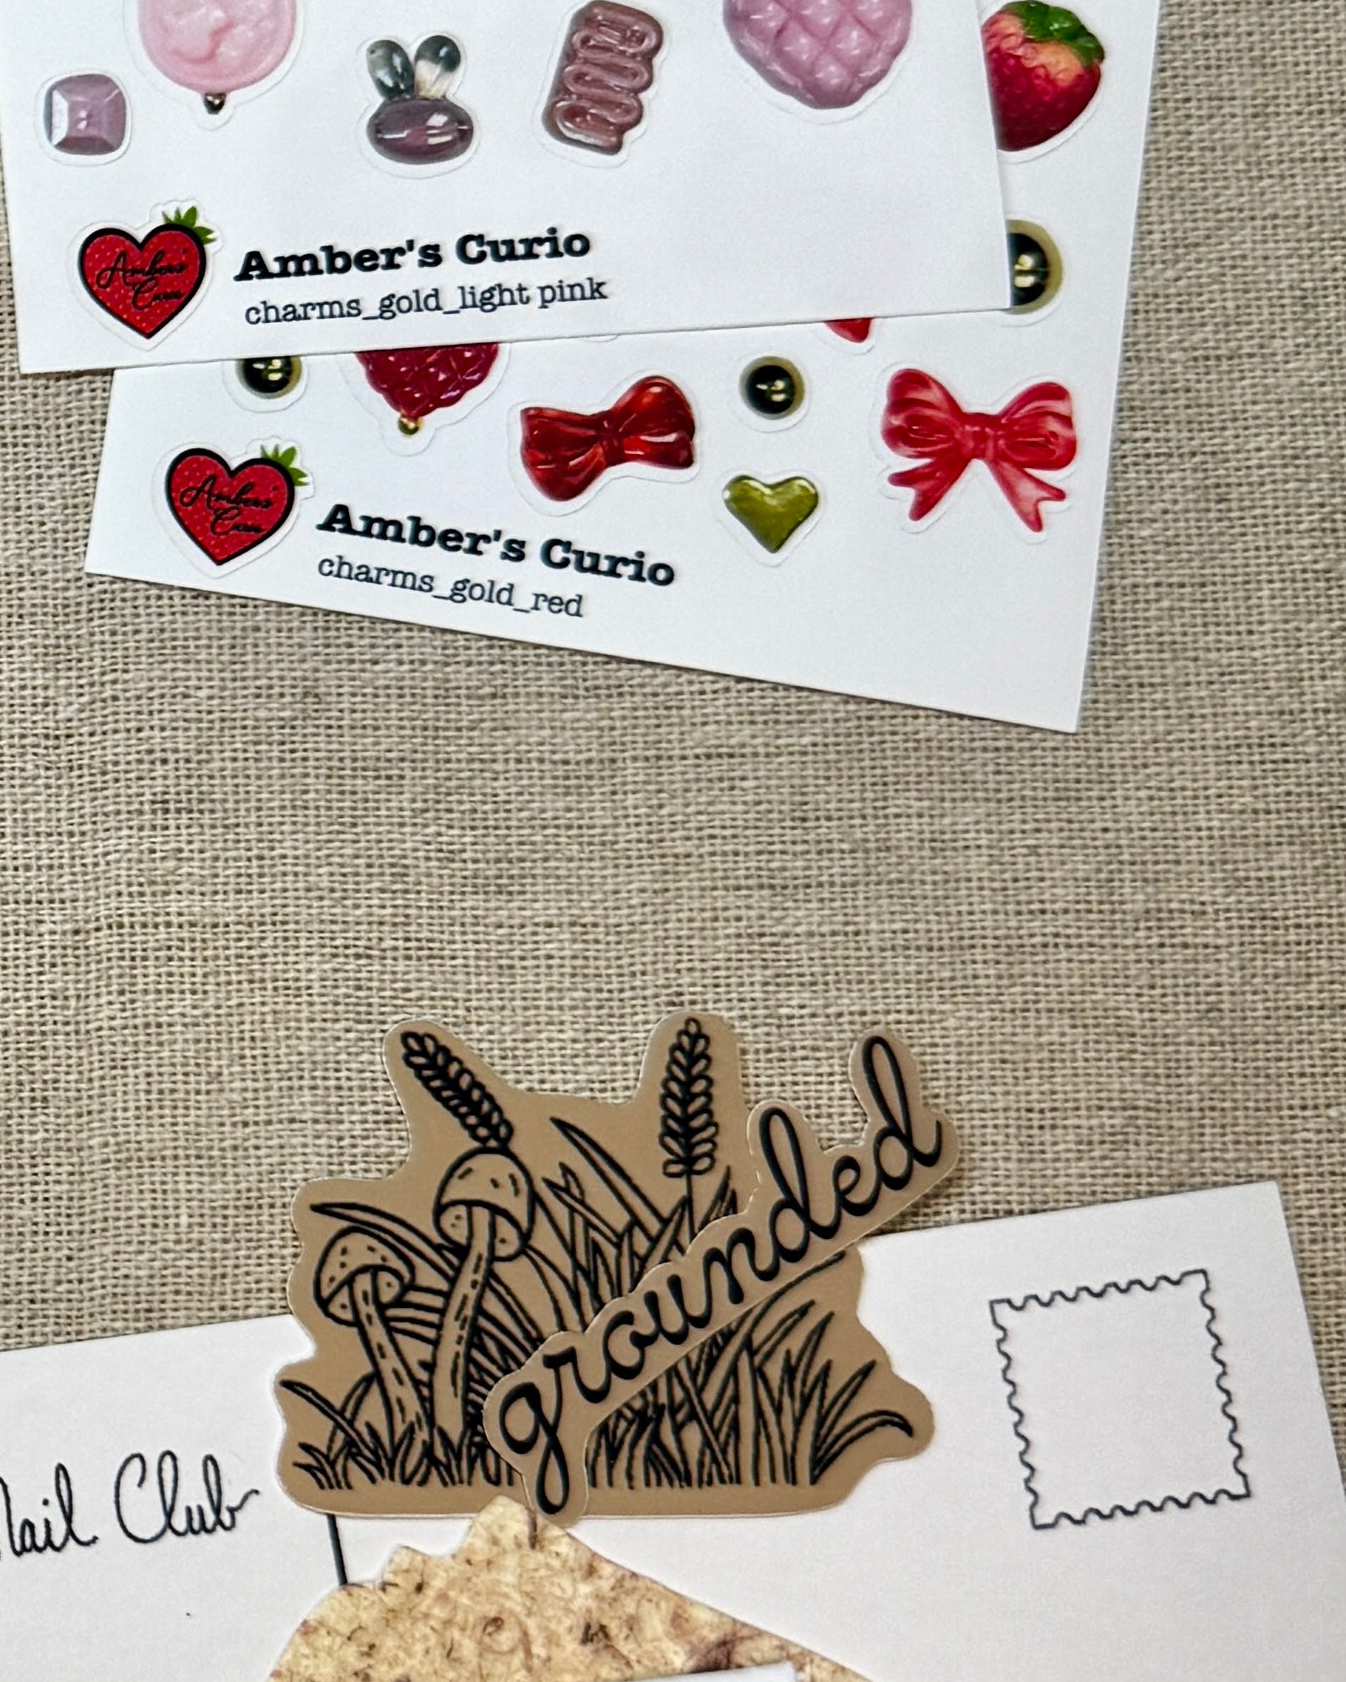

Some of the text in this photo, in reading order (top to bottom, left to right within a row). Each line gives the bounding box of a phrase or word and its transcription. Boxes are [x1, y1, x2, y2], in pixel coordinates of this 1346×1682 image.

[233, 225, 592, 282] Amber's Curio
[244, 276, 608, 326] charms_gold_light pink
[315, 503, 675, 587] Amber's Curio
[317, 554, 584, 618] charms_gold_red
[498, 1035, 943, 1516] grounded
[113, 1448, 260, 1547] Club
